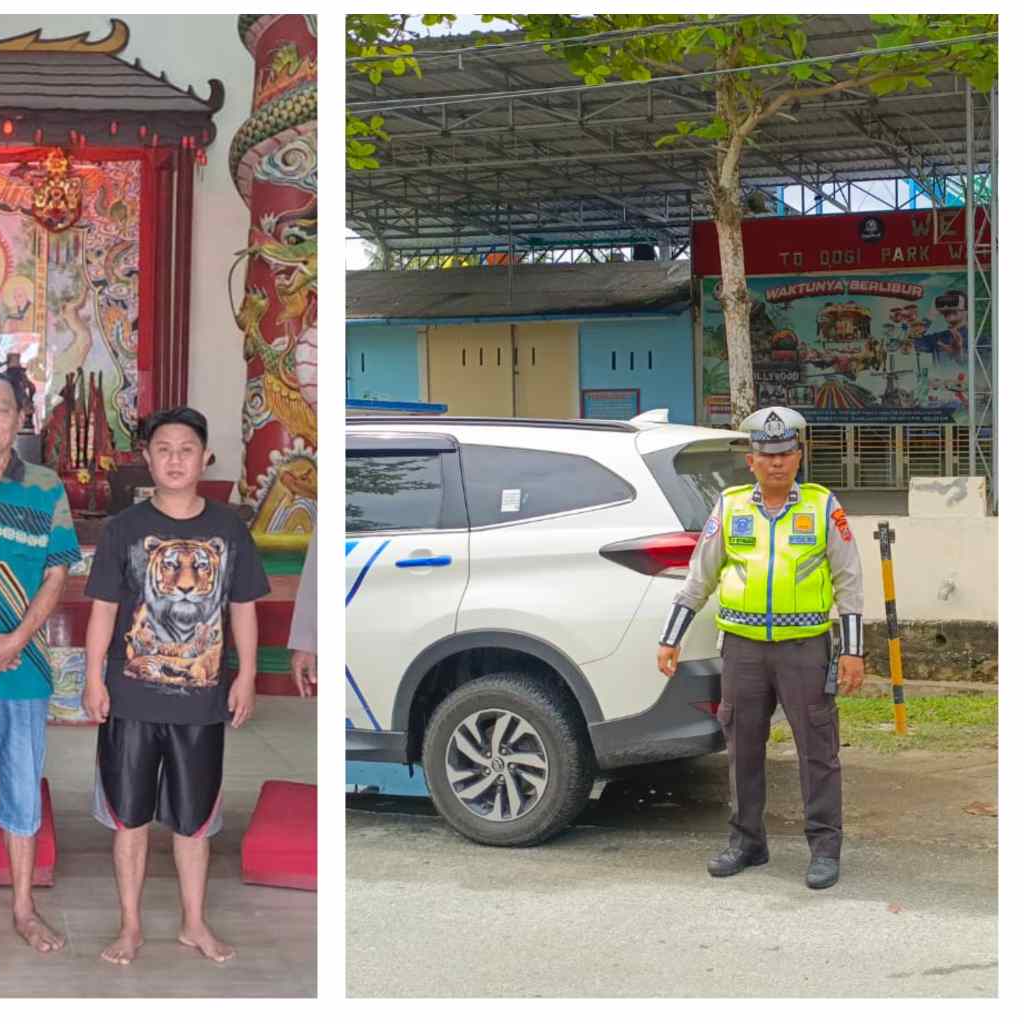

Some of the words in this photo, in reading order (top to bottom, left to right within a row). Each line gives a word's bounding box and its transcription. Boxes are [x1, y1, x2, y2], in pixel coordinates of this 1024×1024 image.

[880, 244, 929, 263] PARK
[766, 279, 845, 302] WAKTUNYA
[847, 279, 924, 297] BERLIBUR
